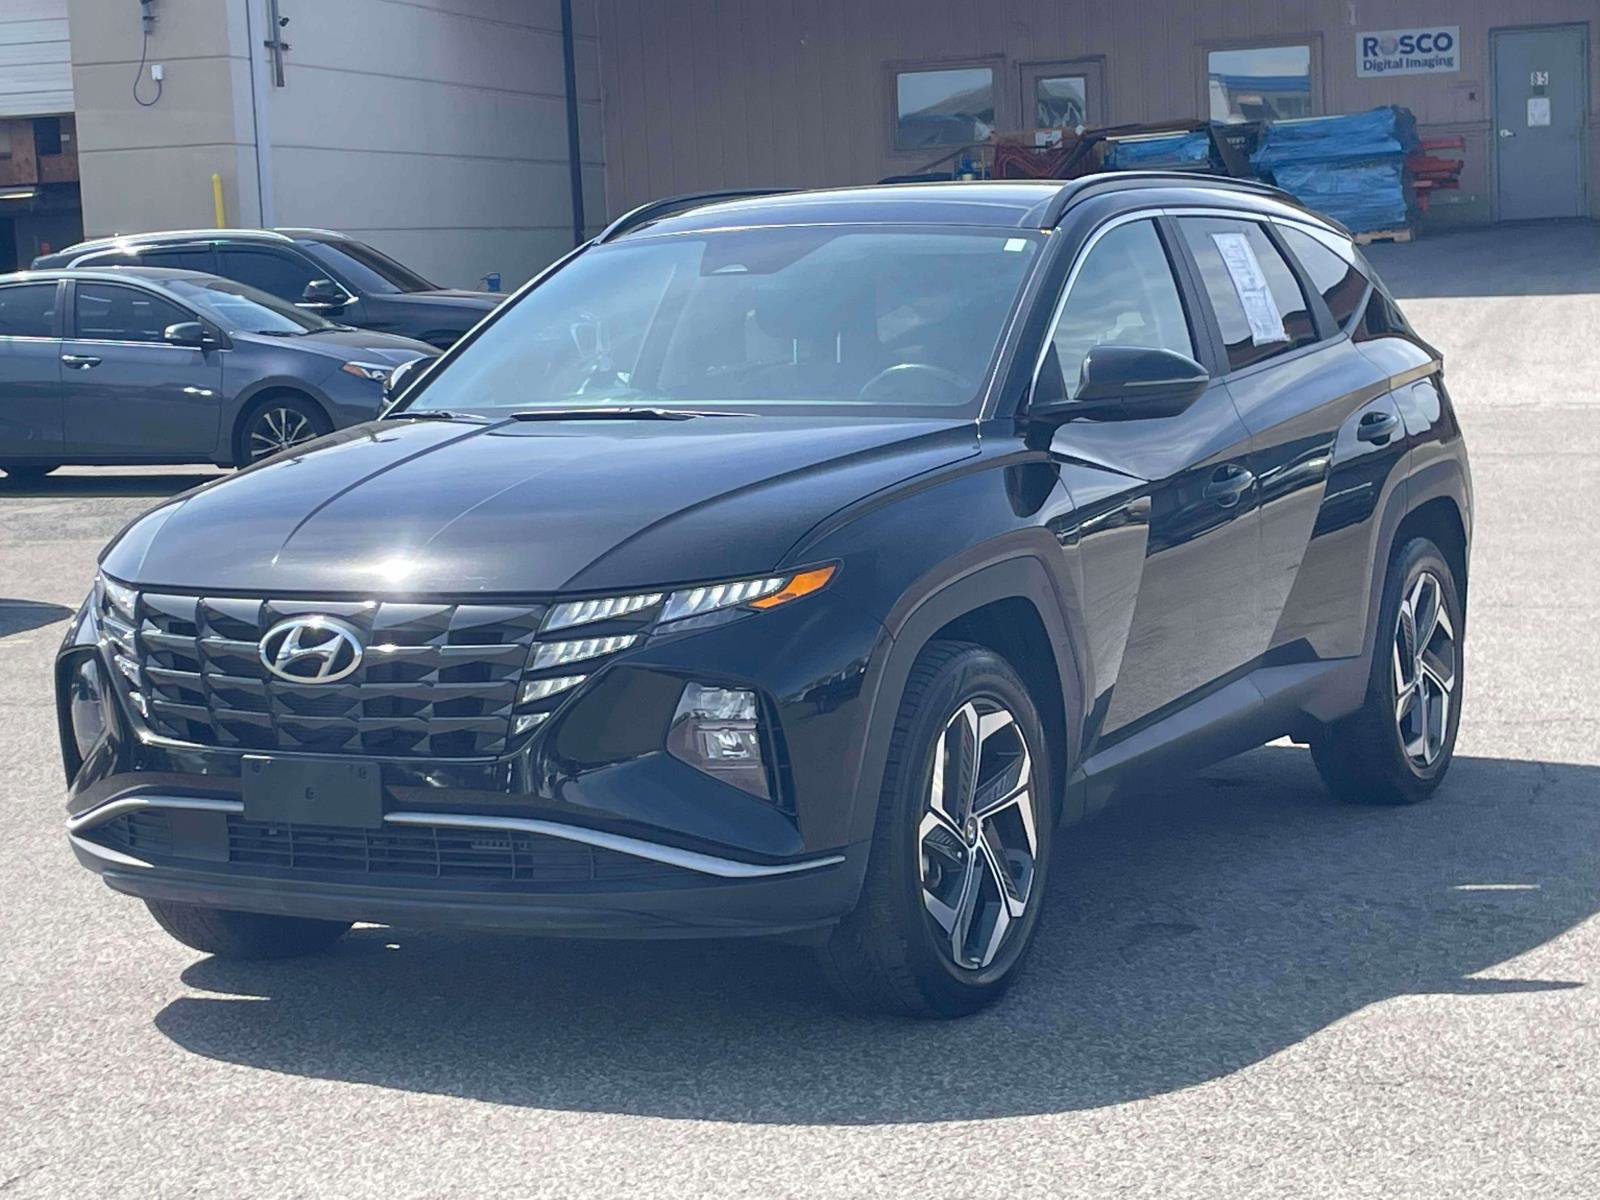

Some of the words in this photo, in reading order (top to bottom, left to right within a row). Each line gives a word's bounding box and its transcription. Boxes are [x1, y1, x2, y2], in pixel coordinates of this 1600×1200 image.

[1363, 32, 1454, 57] ROSCO
[1363, 57, 1403, 72] Digital
[1405, 55, 1454, 69] Imaging
